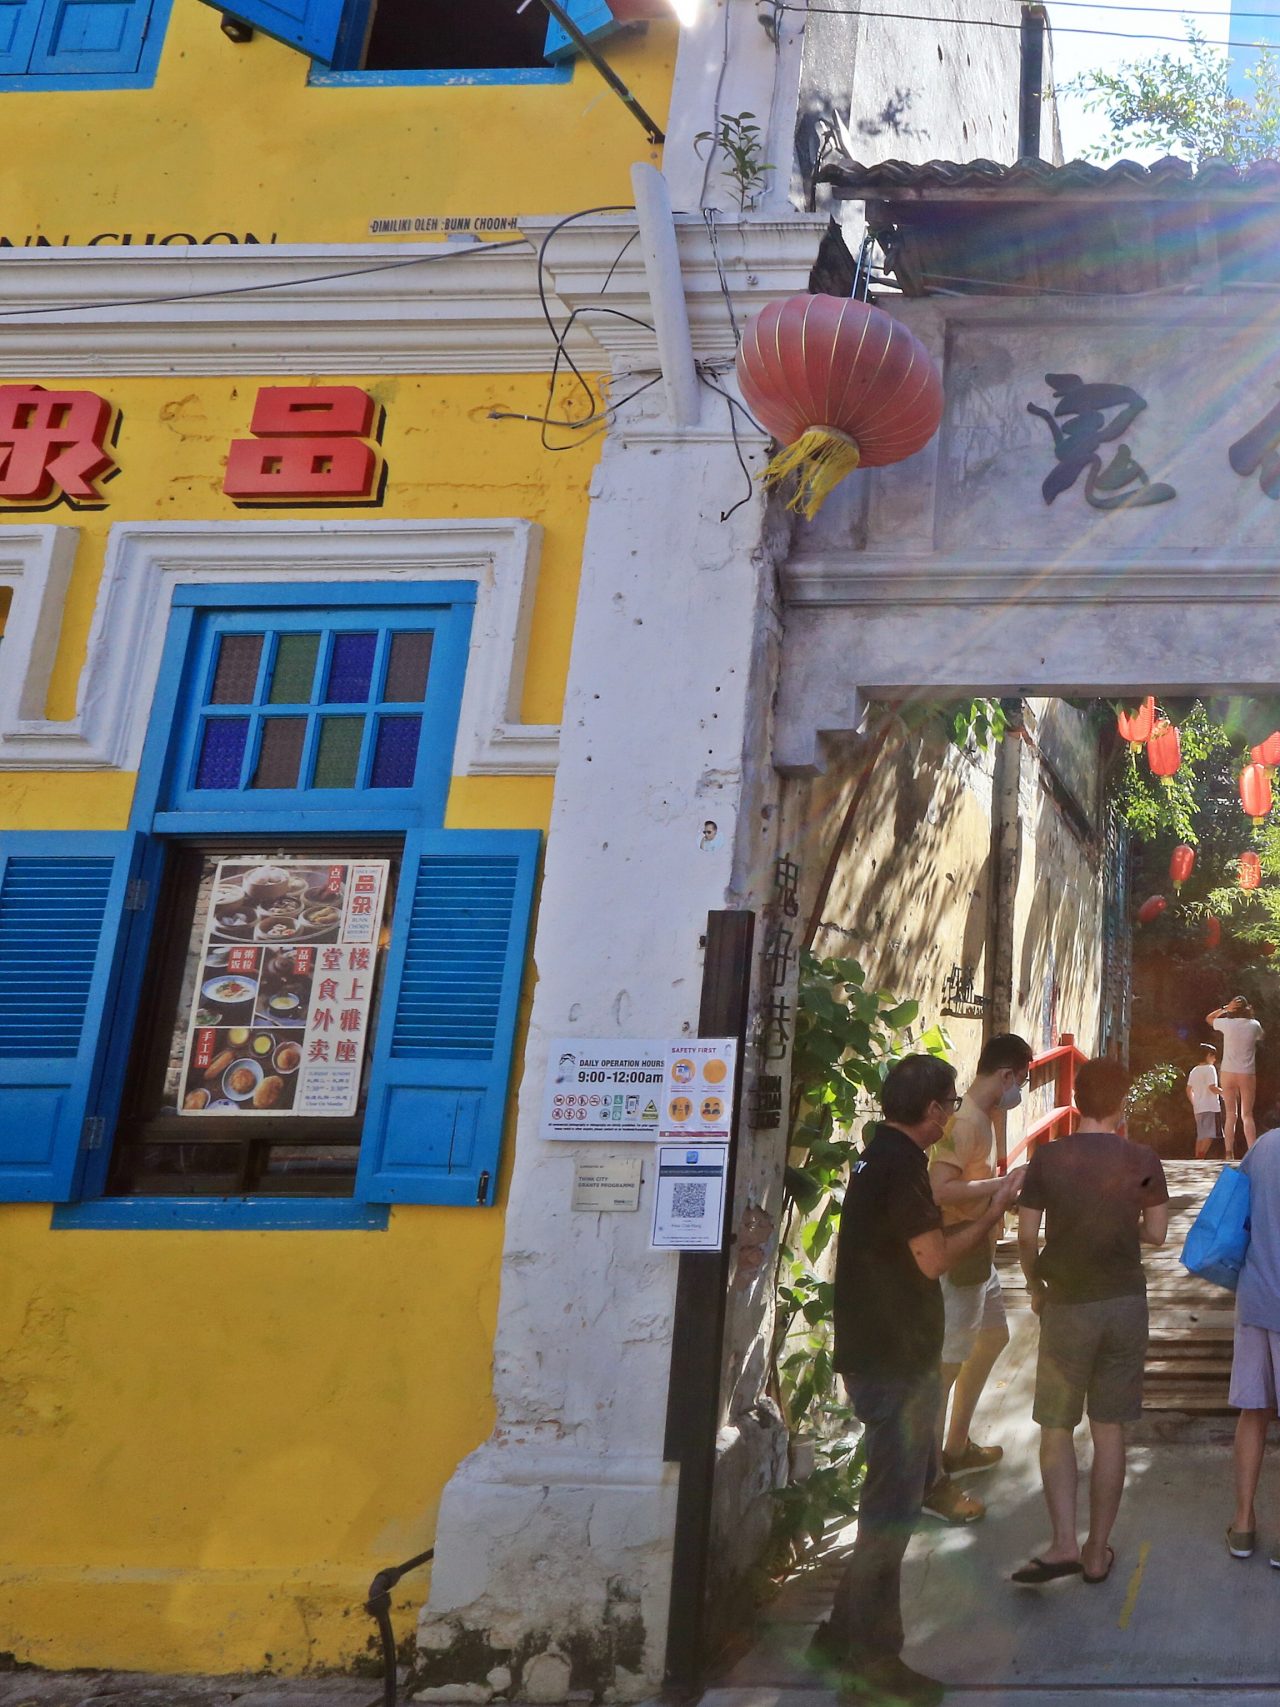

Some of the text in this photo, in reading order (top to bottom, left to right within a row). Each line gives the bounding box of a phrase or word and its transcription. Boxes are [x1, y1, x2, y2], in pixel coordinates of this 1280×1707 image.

[372, 219, 411, 233] DIMILIKI
[414, 218, 438, 231] OLEH
[308, 947, 343, 1063] 堂食外卖
[335, 947, 370, 1063] 楼上雅座
[579, 1059, 664, 1067] DAILY OPERATION HOURS
